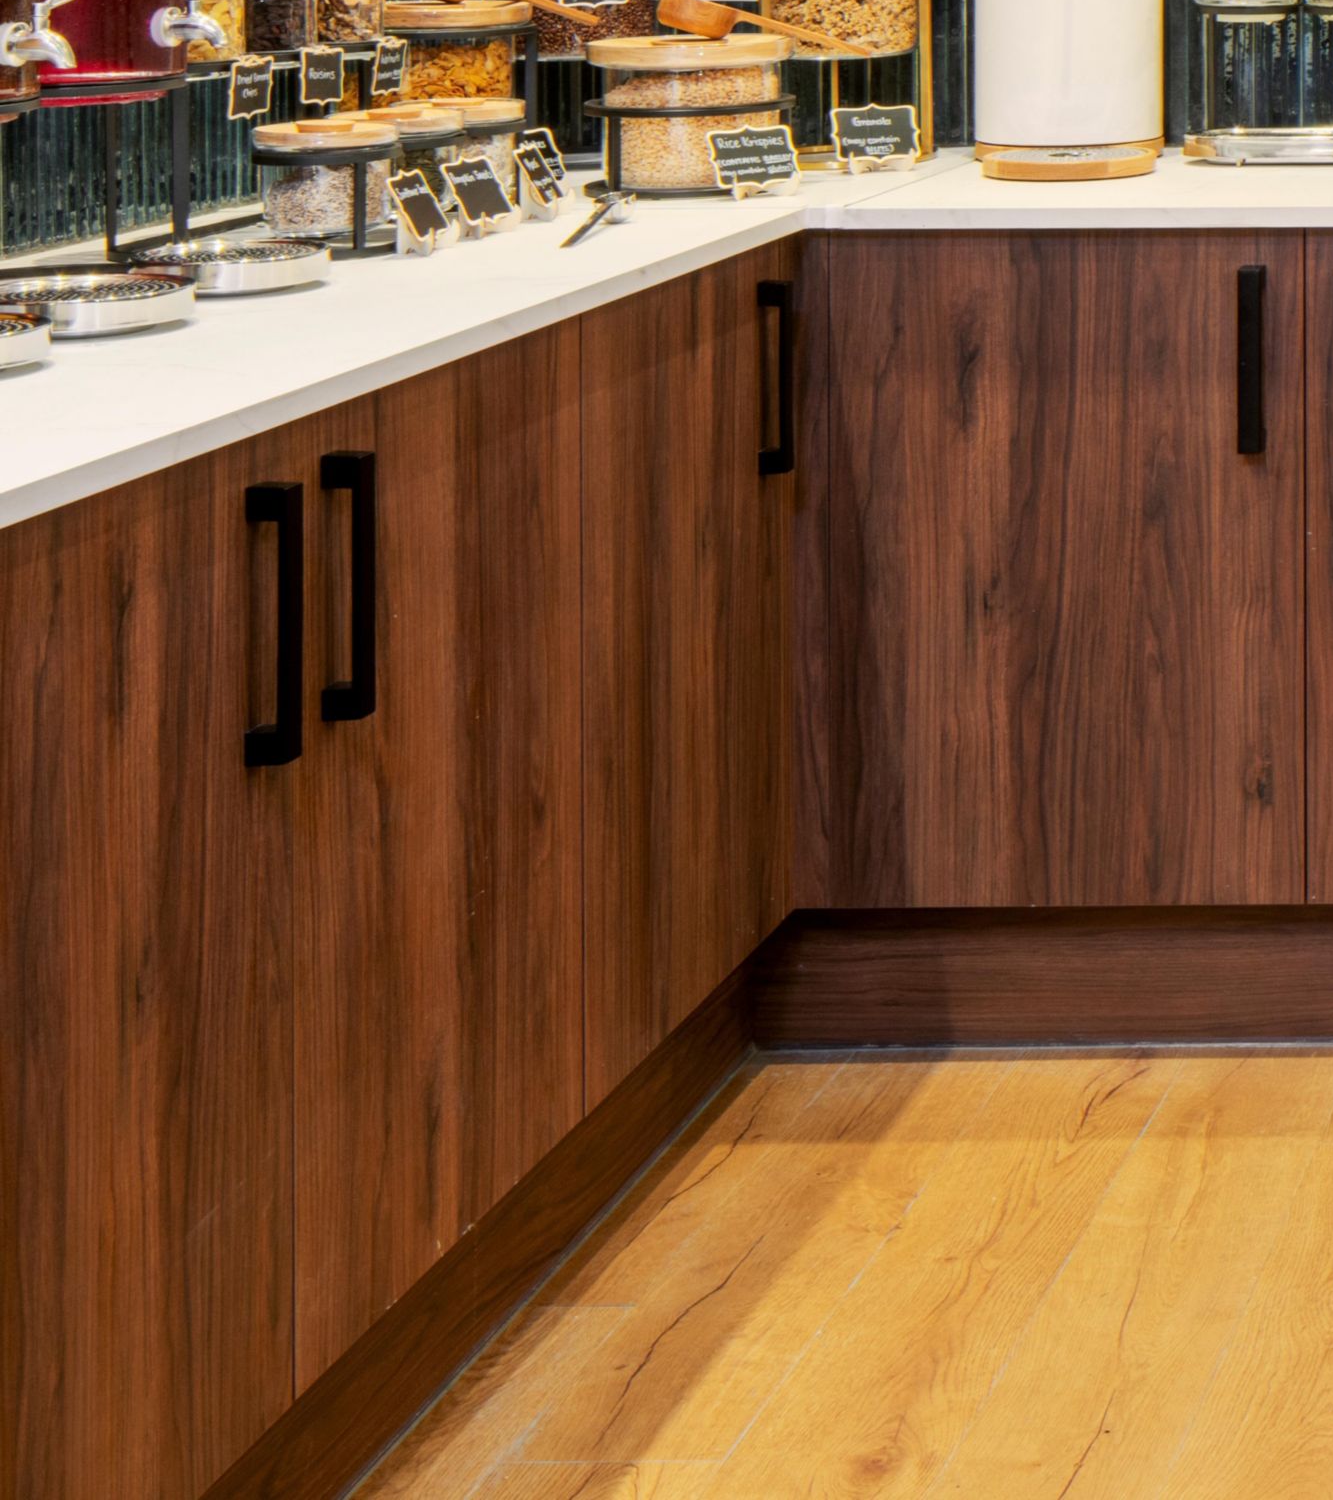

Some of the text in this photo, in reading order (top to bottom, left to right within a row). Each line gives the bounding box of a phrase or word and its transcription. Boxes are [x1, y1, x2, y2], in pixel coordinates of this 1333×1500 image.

[851, 116, 892, 127] Granola
[716, 136, 784, 149] Rice Krispies
